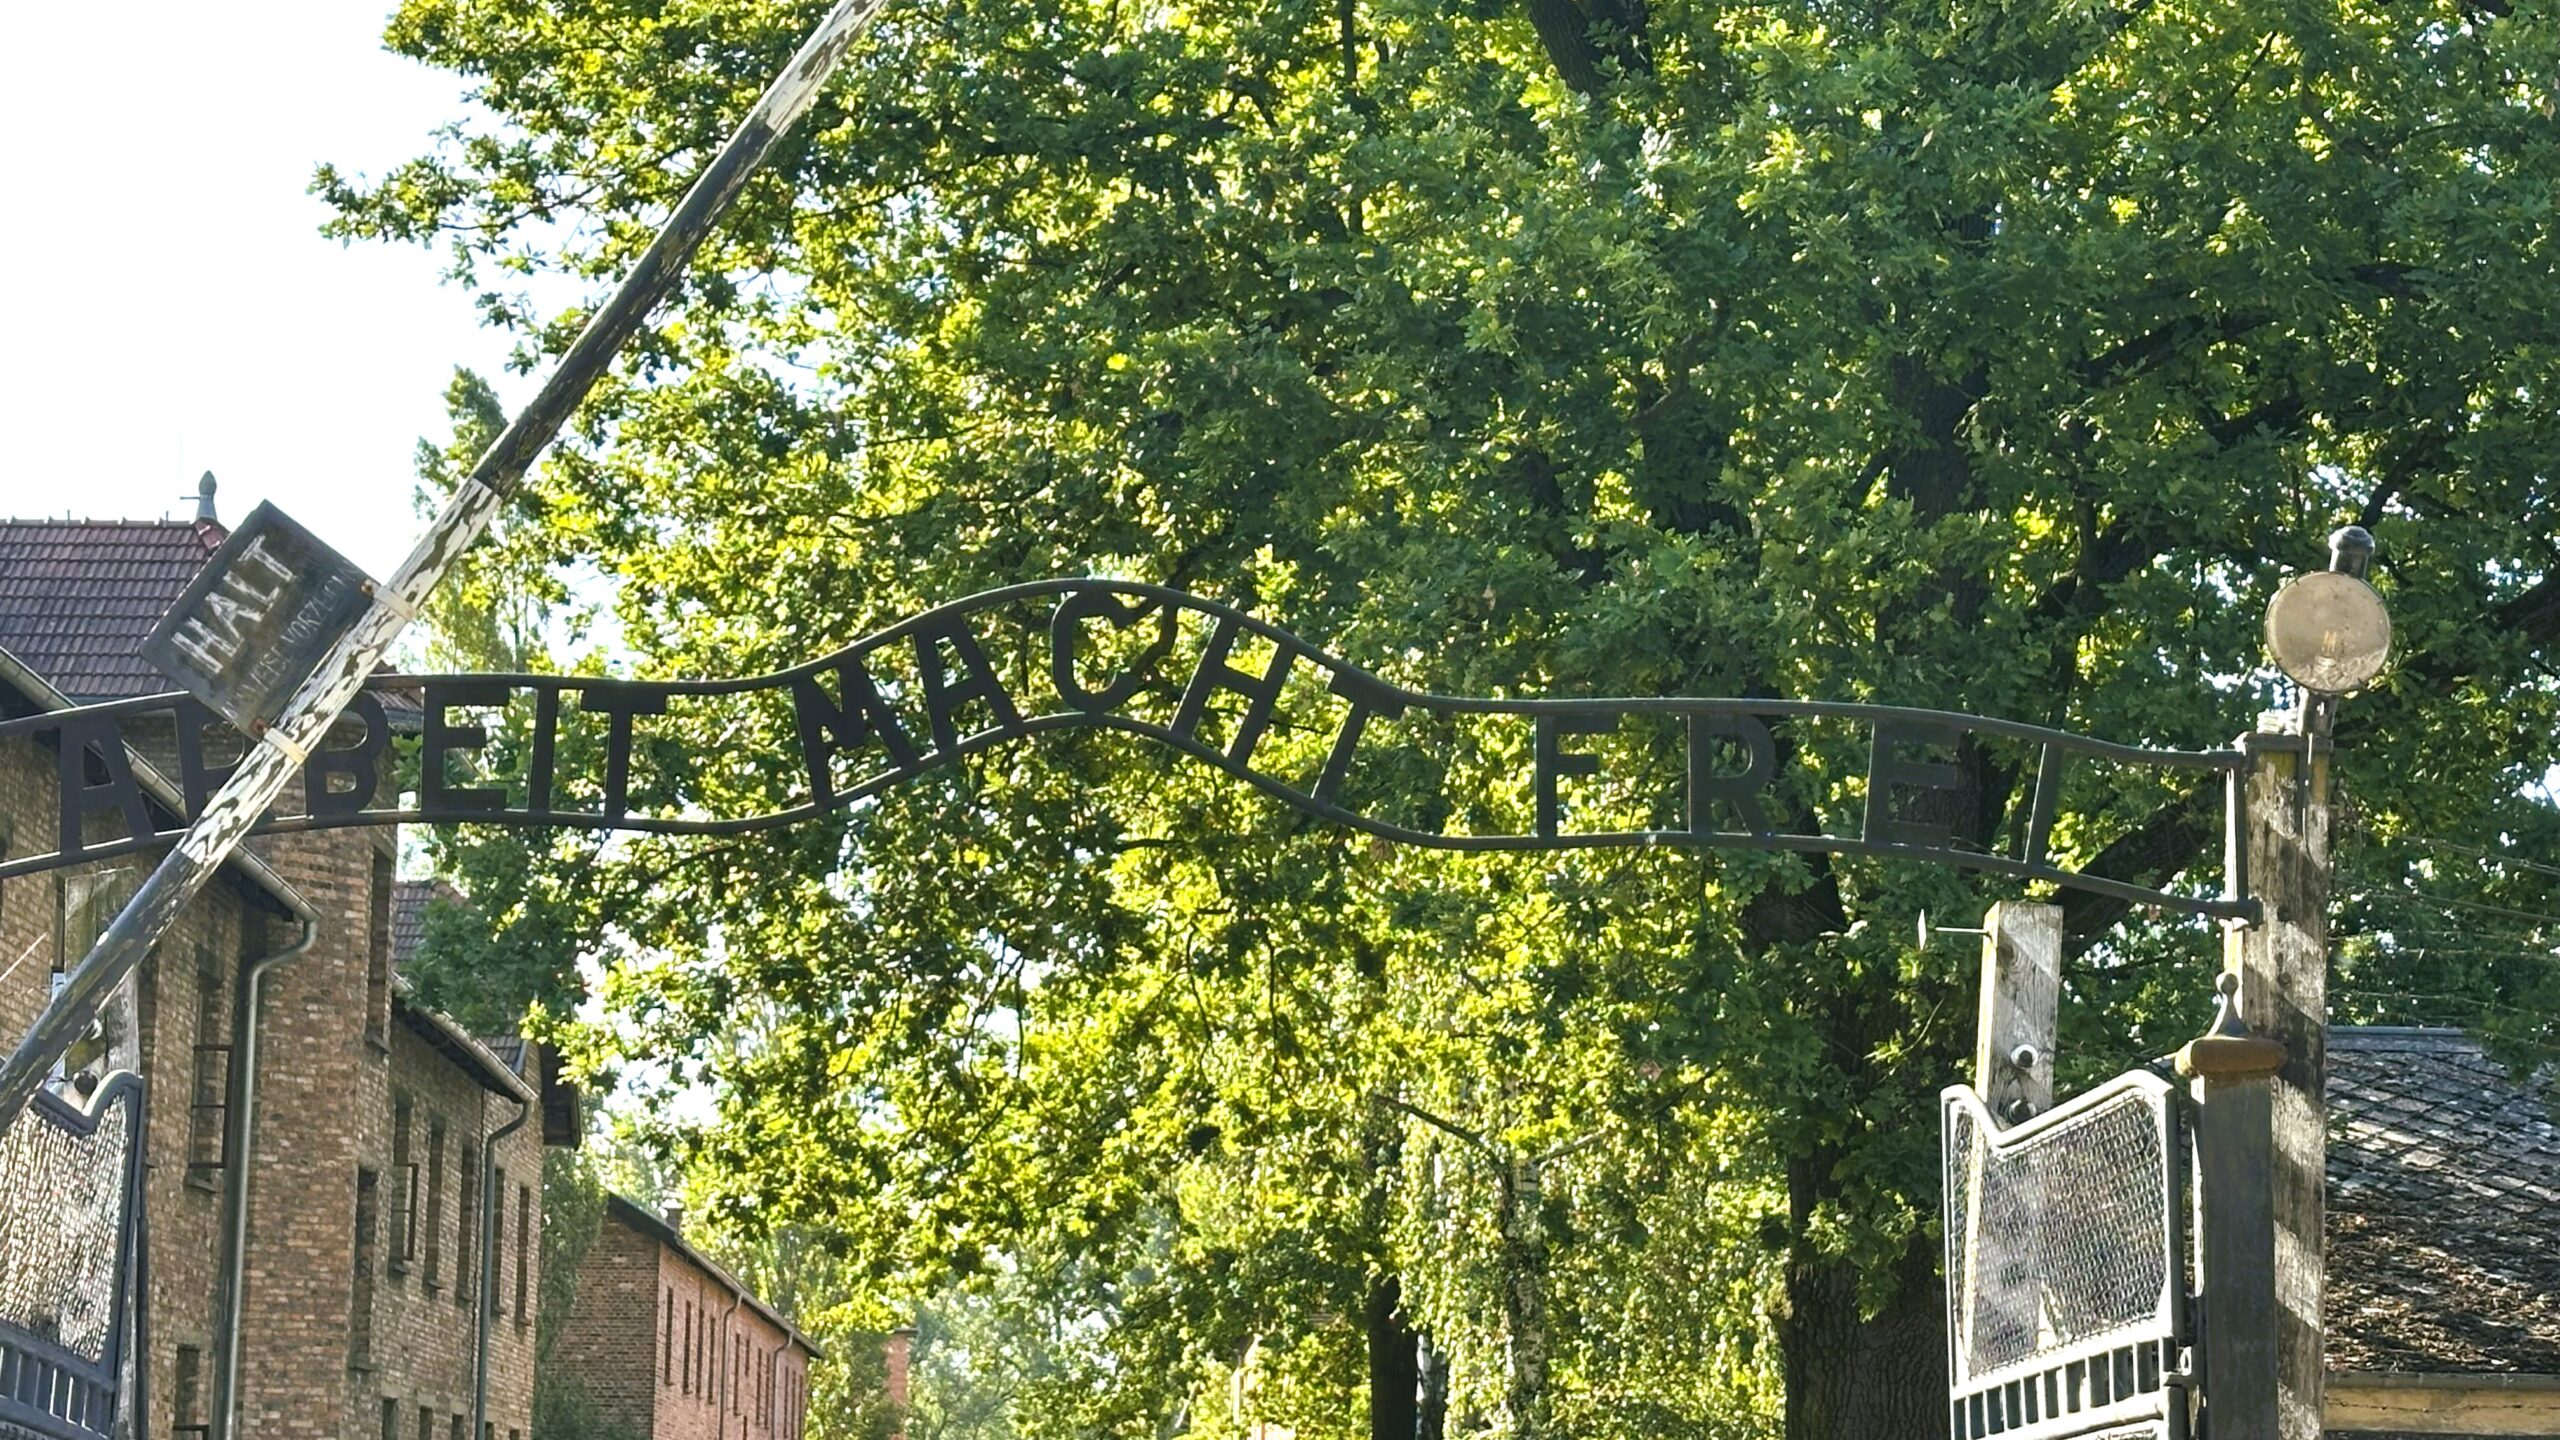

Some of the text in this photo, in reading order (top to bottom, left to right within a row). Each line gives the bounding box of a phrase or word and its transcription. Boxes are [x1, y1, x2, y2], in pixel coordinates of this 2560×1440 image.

[171, 534, 296, 674] HALT
[792, 588, 1401, 800] MACHT
[1535, 708, 2065, 865] FREI
